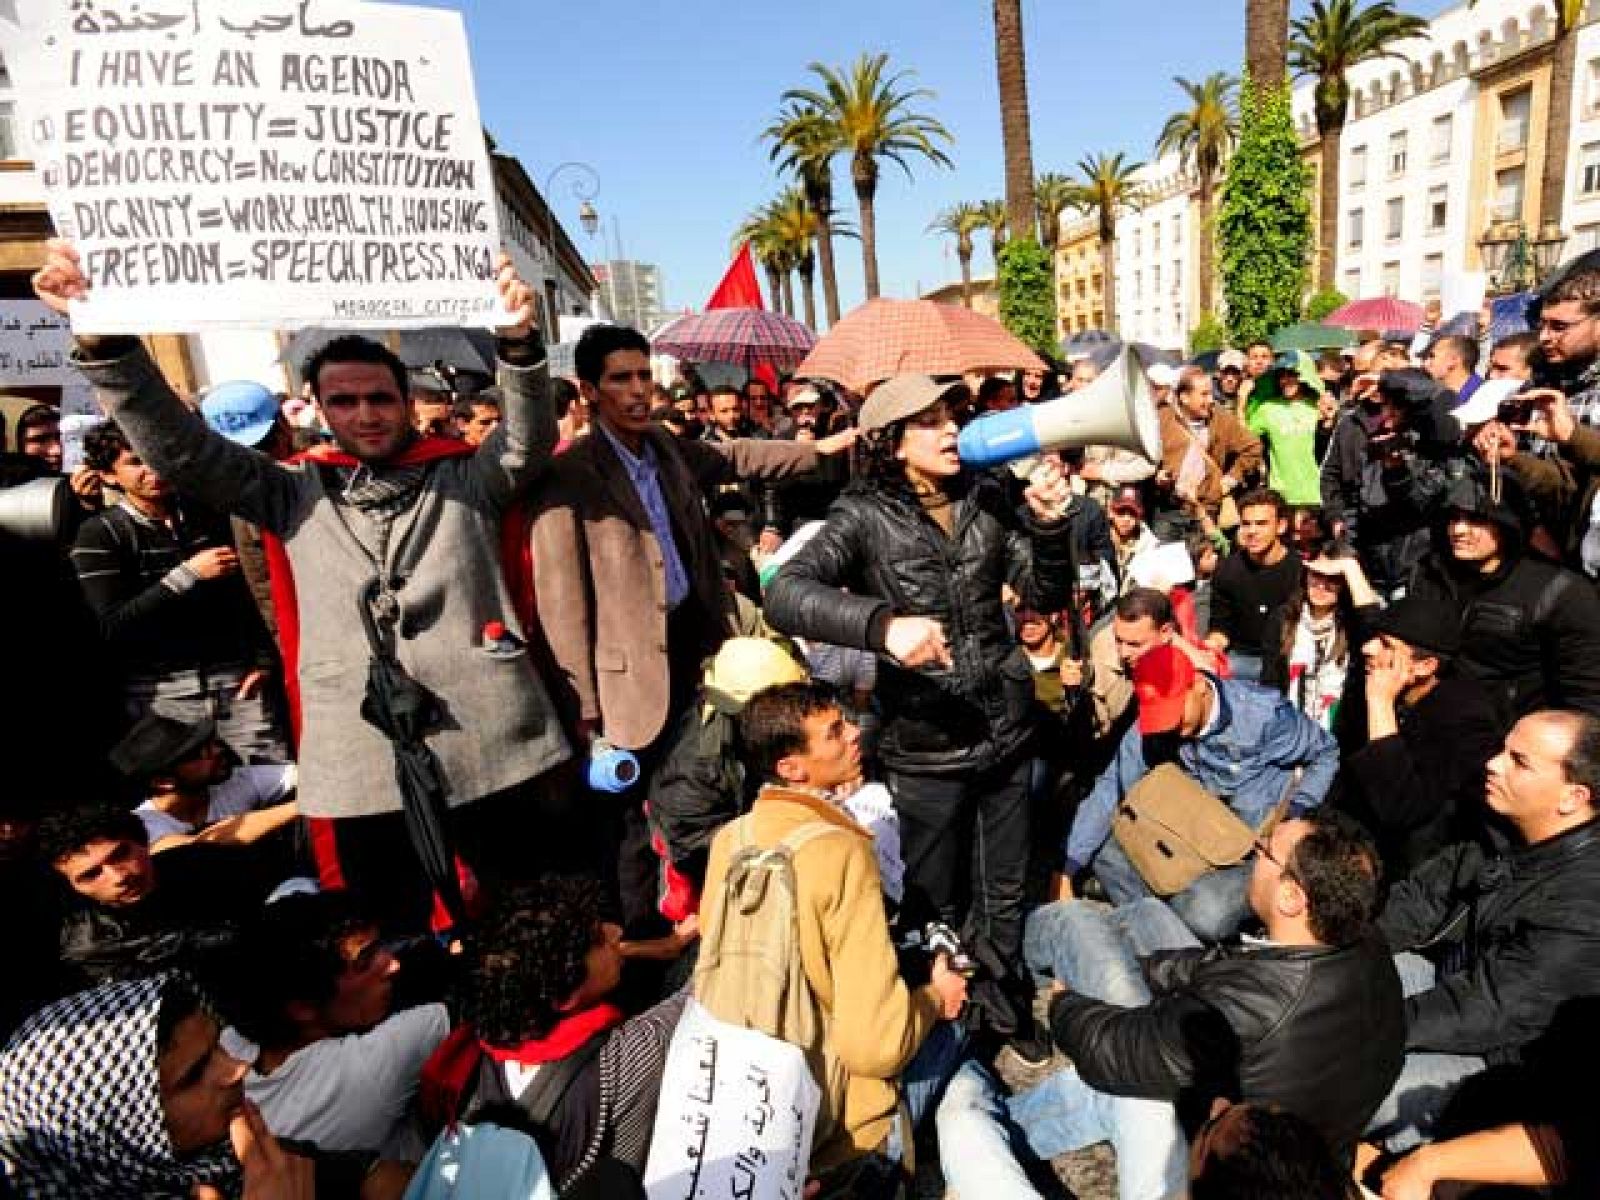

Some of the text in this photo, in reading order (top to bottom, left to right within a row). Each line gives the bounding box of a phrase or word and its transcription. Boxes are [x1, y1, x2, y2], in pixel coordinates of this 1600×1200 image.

[70, 50, 415, 103] I HAVE AN AGENDA
[312, 147, 476, 191] CONSTITUTION
